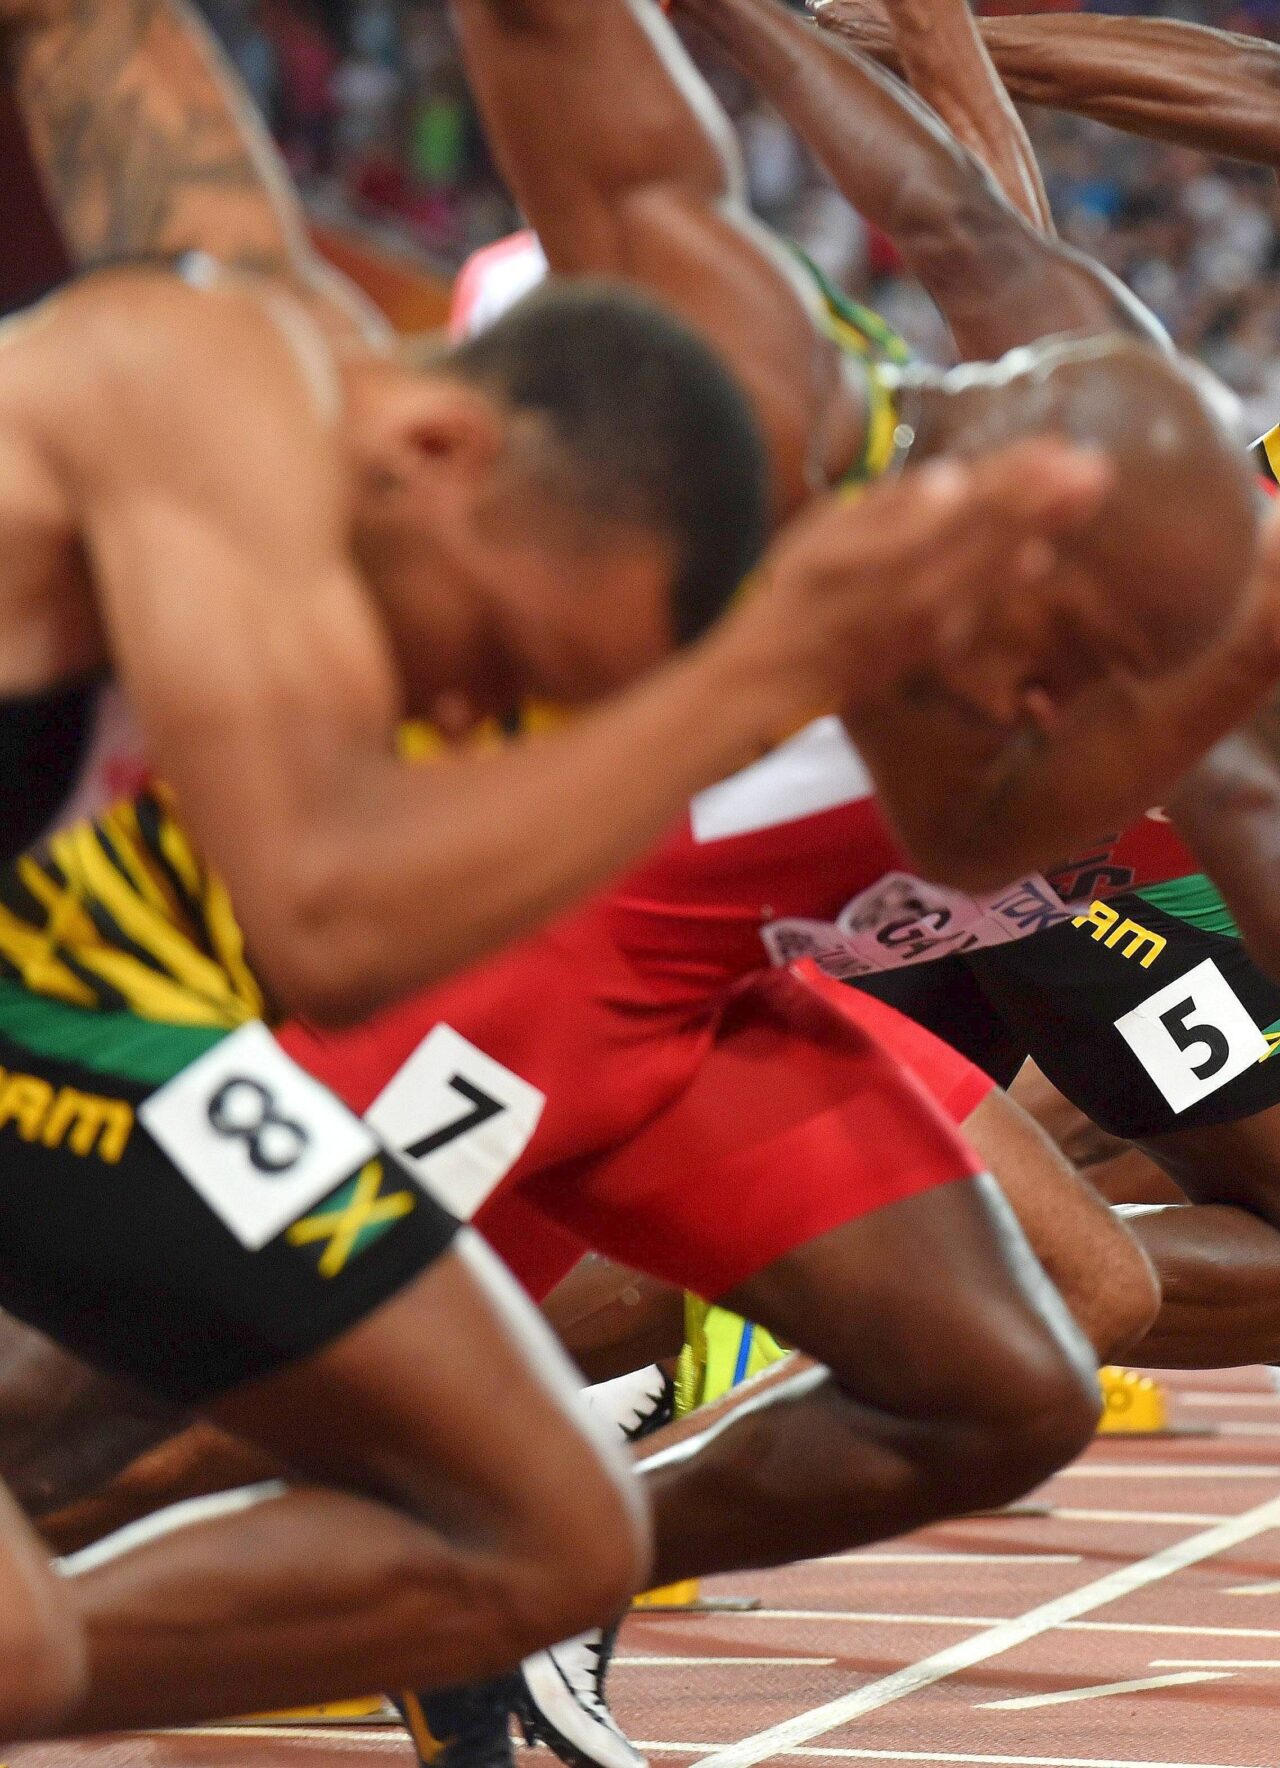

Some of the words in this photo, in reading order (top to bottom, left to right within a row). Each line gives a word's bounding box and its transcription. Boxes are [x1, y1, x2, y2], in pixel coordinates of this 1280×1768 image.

[1071, 900, 1168, 969] AM
[1159, 995, 1230, 1081] 5
[0, 1064, 134, 1165] AM
[207, 1076, 310, 1175] 8
[402, 1072, 506, 1159] 7
